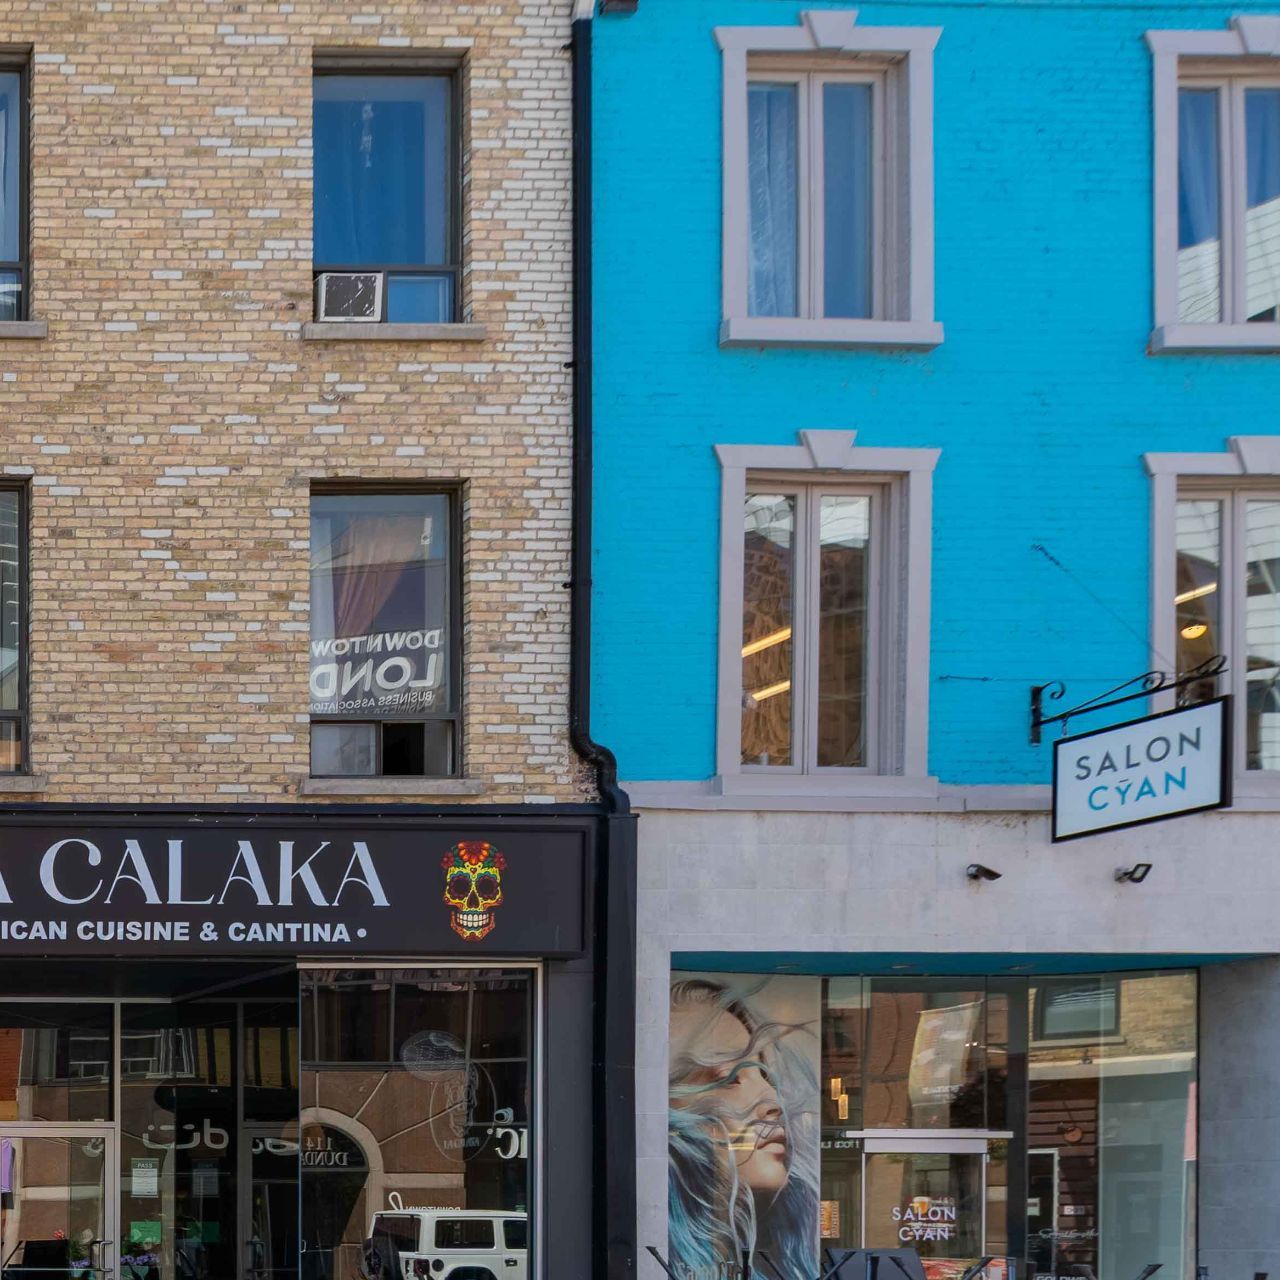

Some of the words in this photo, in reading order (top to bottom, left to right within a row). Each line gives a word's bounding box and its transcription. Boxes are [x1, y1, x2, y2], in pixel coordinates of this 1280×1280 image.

[1075, 726, 1201, 781] SALON
[39, 838, 391, 907] CALAKA
[76, 920, 189, 942] CUISINE
[199, 922, 219, 942] &
[228, 922, 351, 943] CANTINA
[892, 1206, 957, 1221] SALON
